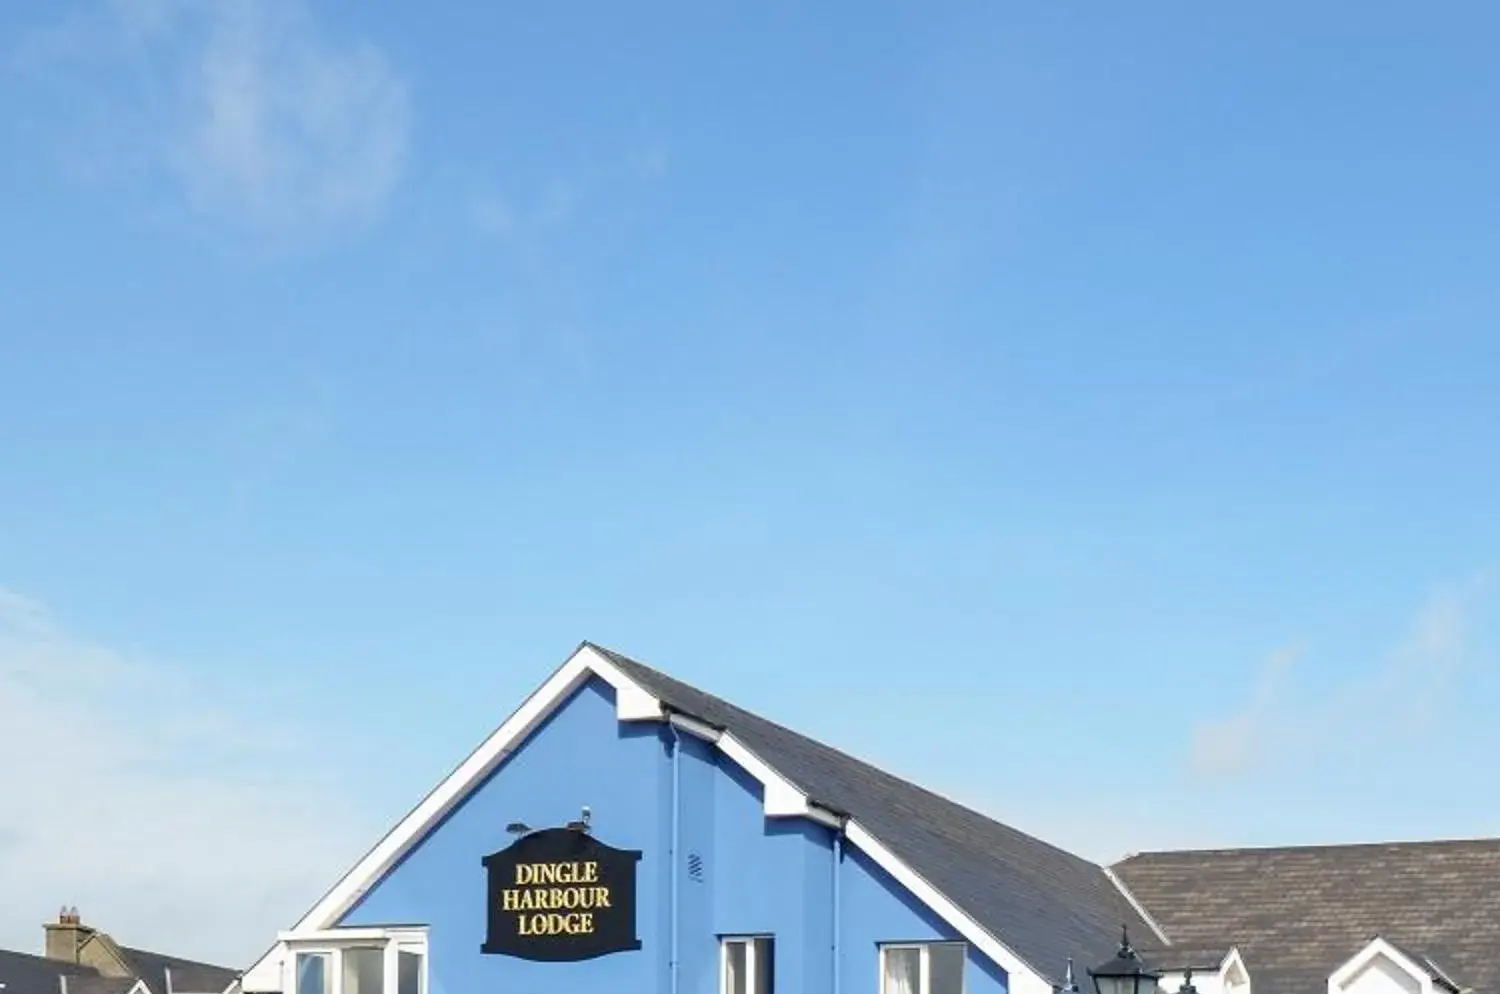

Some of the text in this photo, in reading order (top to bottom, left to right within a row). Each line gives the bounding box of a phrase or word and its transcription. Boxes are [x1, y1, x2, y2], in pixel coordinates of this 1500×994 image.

[515, 861, 599, 885] DINGLE
[501, 887, 612, 911] HARBOUR
[518, 913, 594, 935] LODGE
